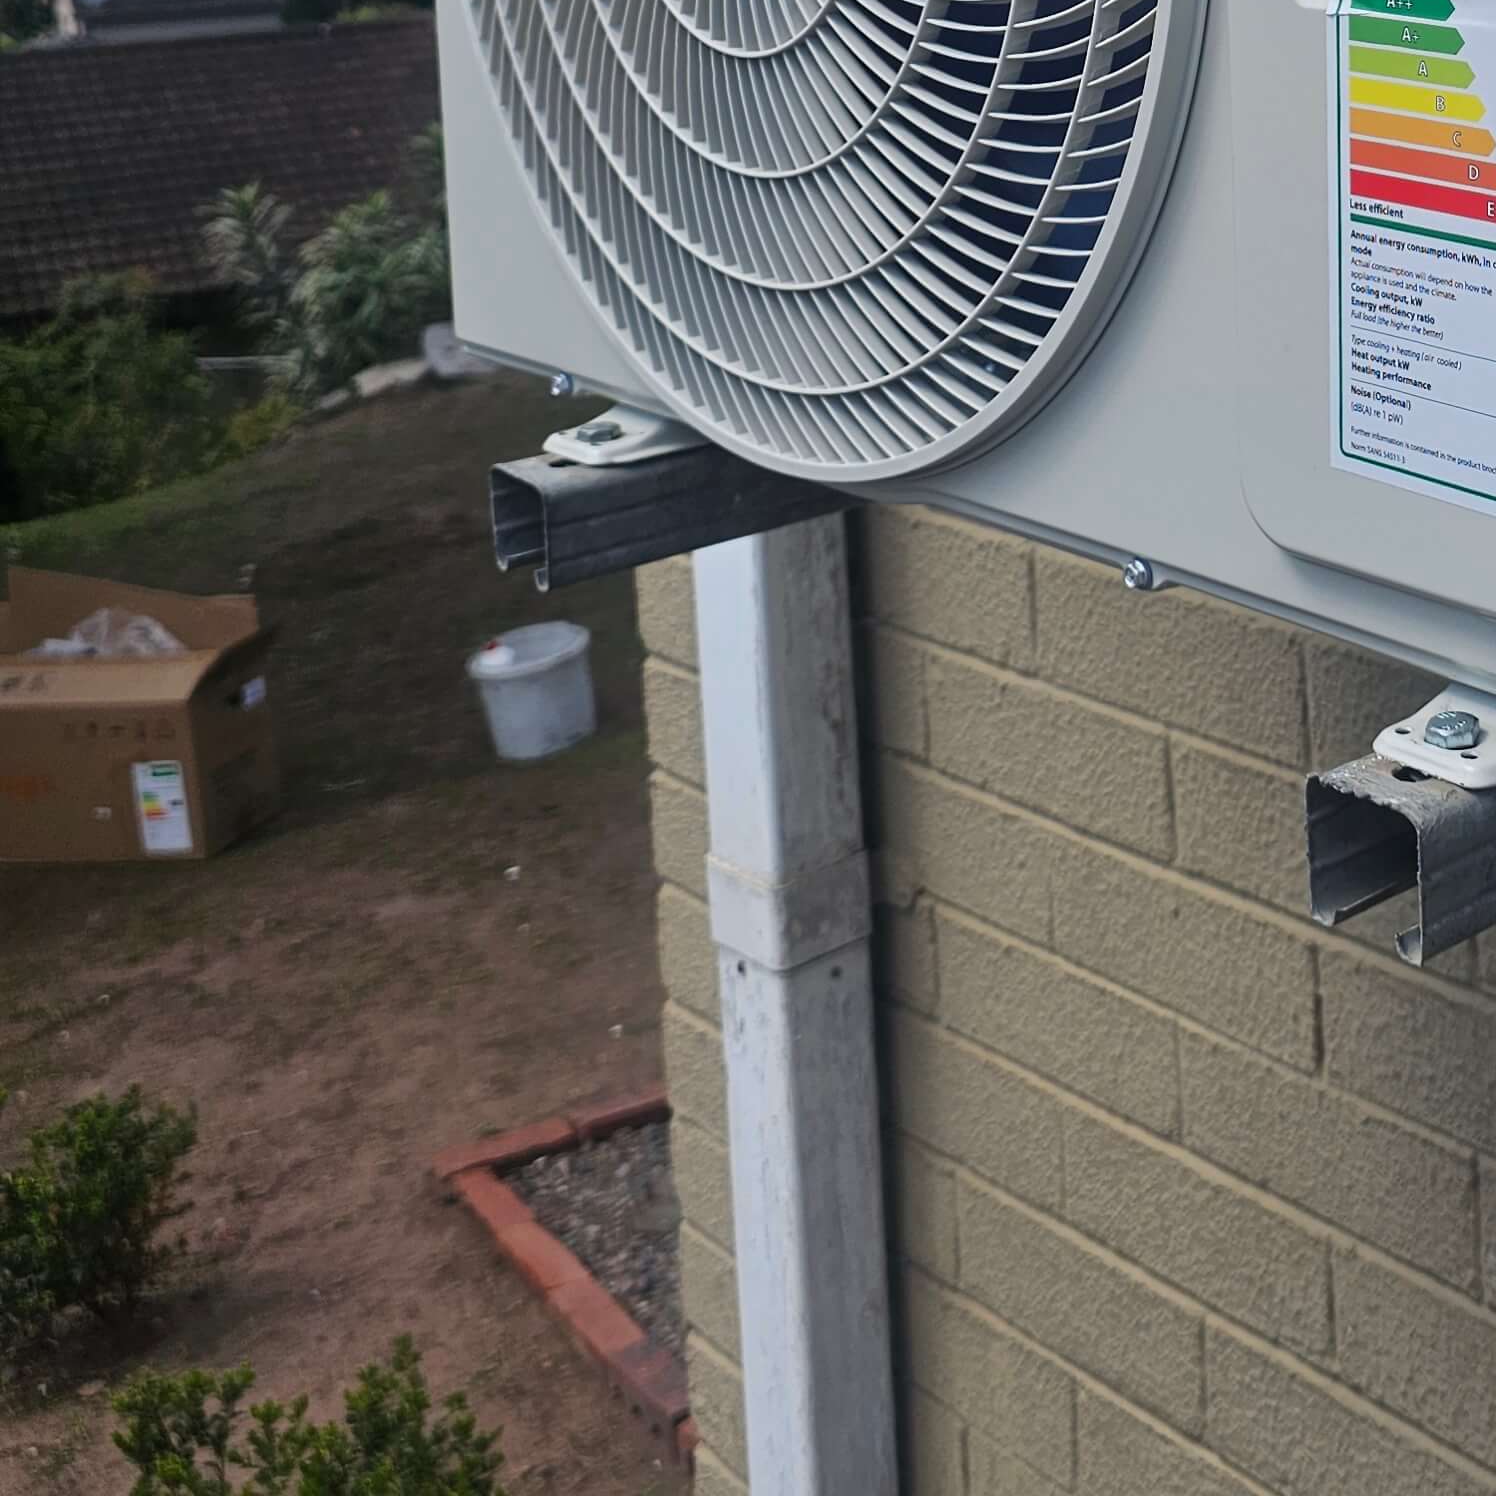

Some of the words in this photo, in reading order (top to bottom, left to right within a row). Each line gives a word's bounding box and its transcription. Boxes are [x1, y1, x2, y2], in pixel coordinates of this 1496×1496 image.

[1401, 29, 1420, 43] A+
[1417, 62, 1428, 76] A
[1436, 96, 1445, 111] B
[1453, 132, 1462, 146] C
[1468, 165, 1479, 180] D
[1349, 199, 1366, 214] Less
[1368, 203, 1404, 219] efficient
[1487, 202, 1495, 217] E
[1351, 230, 1376, 243] Annual
[1379, 237, 1405, 251] energy
[1407, 243, 1460, 262] consumption,
[1461, 252, 1482, 267] kWh,
[1351, 245, 1372, 256] mode
[1351, 257, 1370, 268] Actual
[1371, 262, 1414, 278] consumption
[1428, 274, 1453, 287] depend
[1454, 281, 1463, 289] on
[1464, 281, 1480, 292] how
[1481, 285, 1493, 296] the
[1351, 282, 1380, 299] Cooling
[1381, 289, 1409, 305] output,
[1410, 295, 1423, 307] kW
[1405, 283, 1418, 292] and
[1418, 284, 1430, 295] the
[1351, 296, 1377, 312] Energy
[1378, 304, 1416, 322] efficiency
[1416, 313, 1435, 325] ratio
[1351, 309, 1362, 319] Full
[1362, 312, 1377, 322] load
[1390, 319, 1410, 331] higher
[1411, 323, 1422, 334] the
[1351, 334, 1366, 345] Type
[1366, 339, 1390, 353] cooling
[1396, 346, 1420, 361] heating
[1436, 357, 1462, 371] cooled)
[1351, 347, 1369, 361] Heat
[1370, 354, 1397, 367] output
[1397, 360, 1410, 371] kW
[1351, 361, 1381, 379] Heating
[1381, 371, 1432, 391] performance
[1350, 385, 1371, 399] Noise
[1372, 390, 1412, 411] (Optional)
[1457, 457, 1481, 471] product
